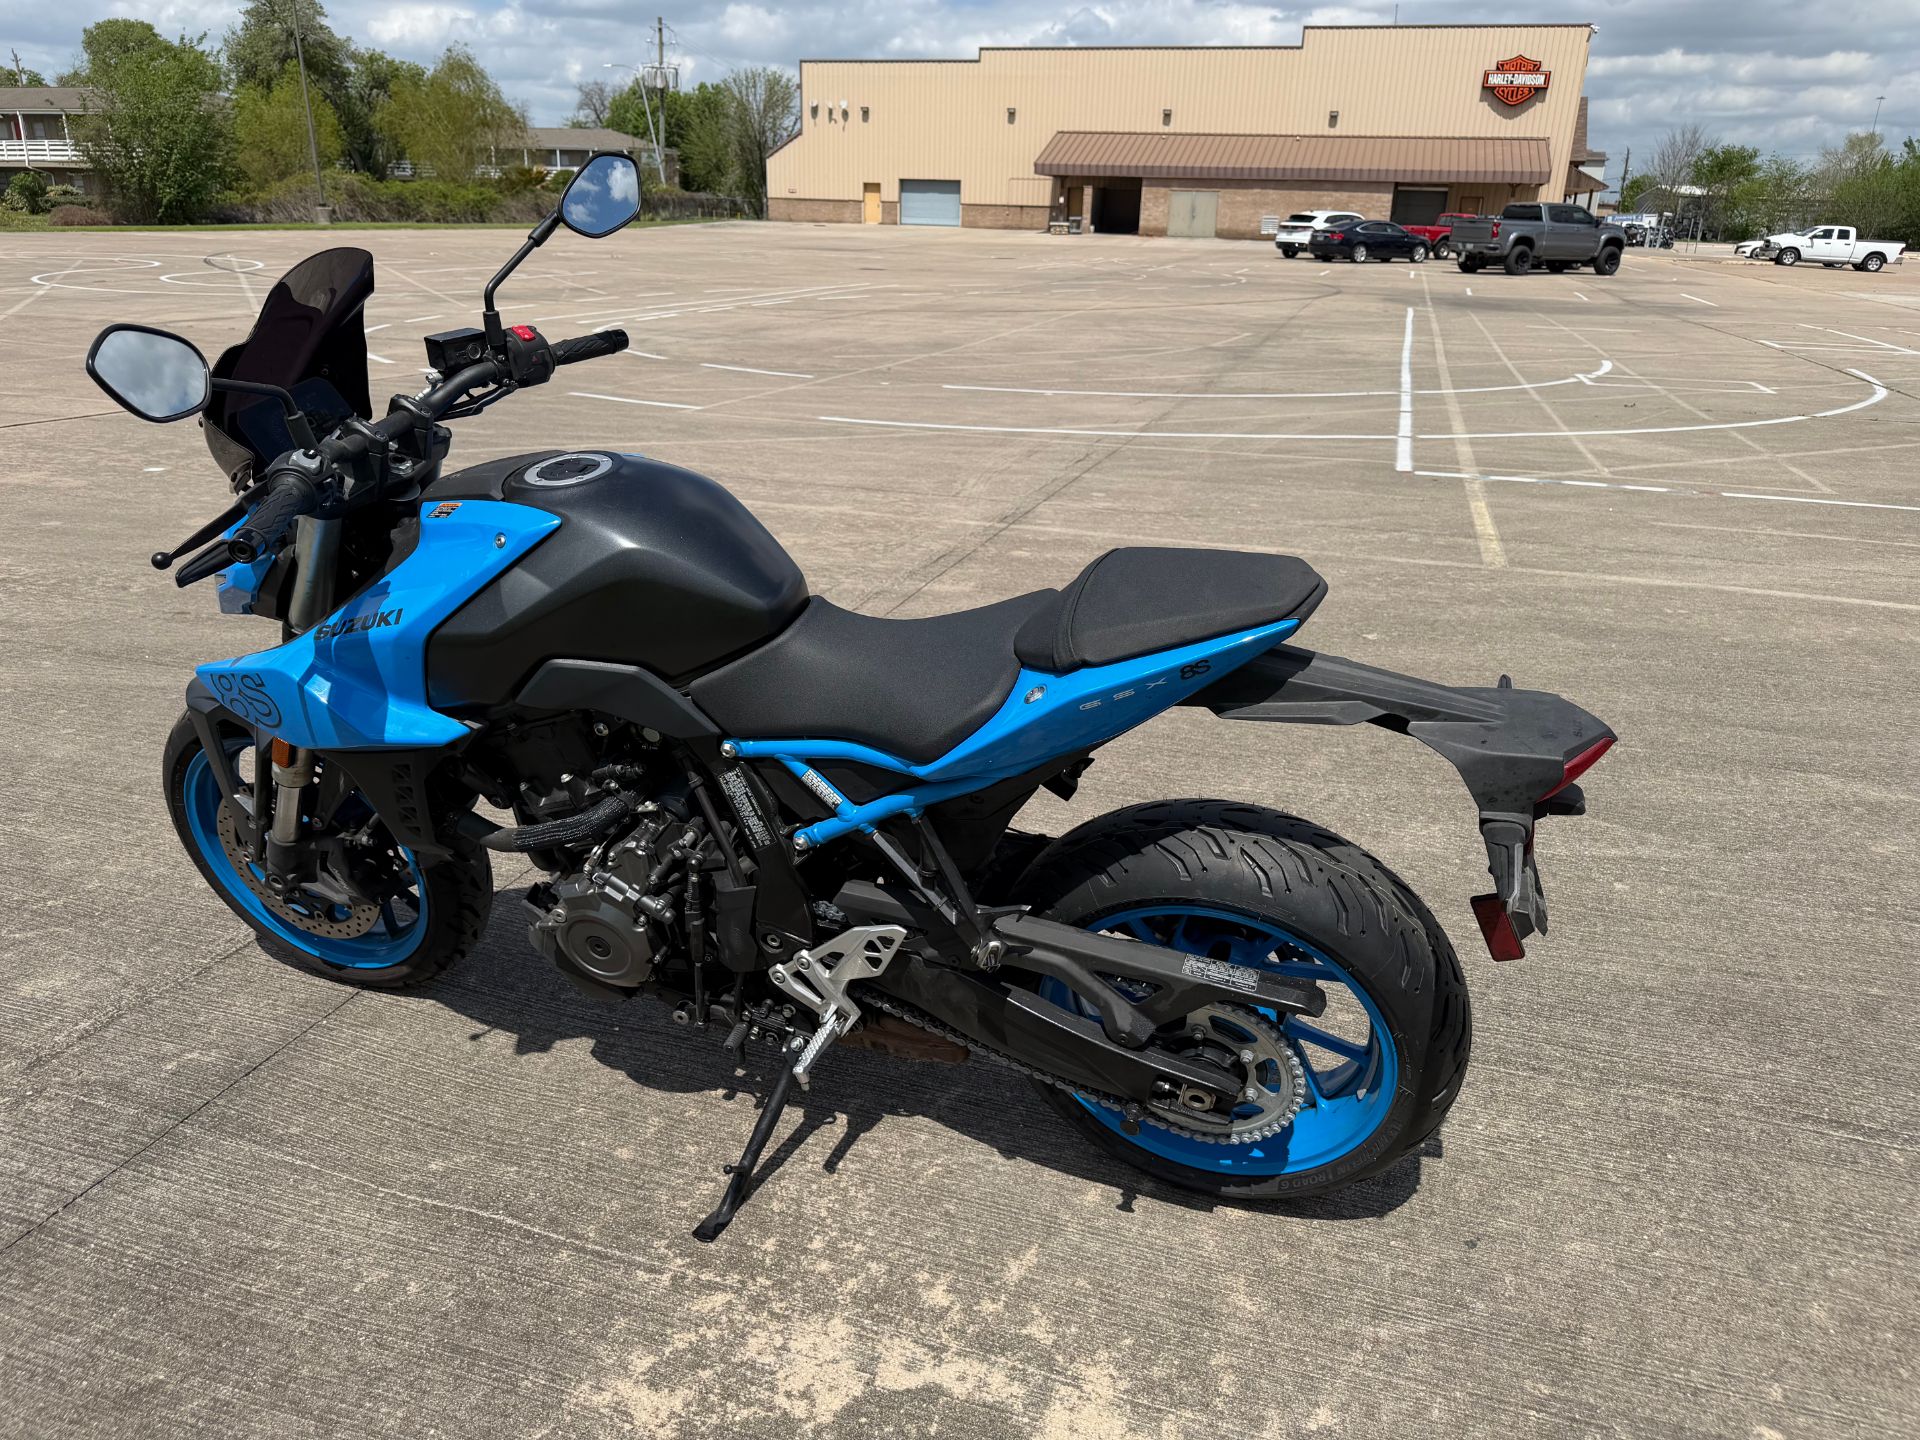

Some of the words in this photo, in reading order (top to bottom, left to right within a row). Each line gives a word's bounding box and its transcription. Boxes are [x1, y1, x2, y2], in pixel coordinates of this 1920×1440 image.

[1503, 61, 1534, 71] MOTOR
[1487, 73, 1546, 86] HARLEY-DAVIDSON
[1499, 87, 1530, 101] CYCLES
[314, 608, 404, 641] SUZUKI
[1179, 659, 1212, 681] 8S
